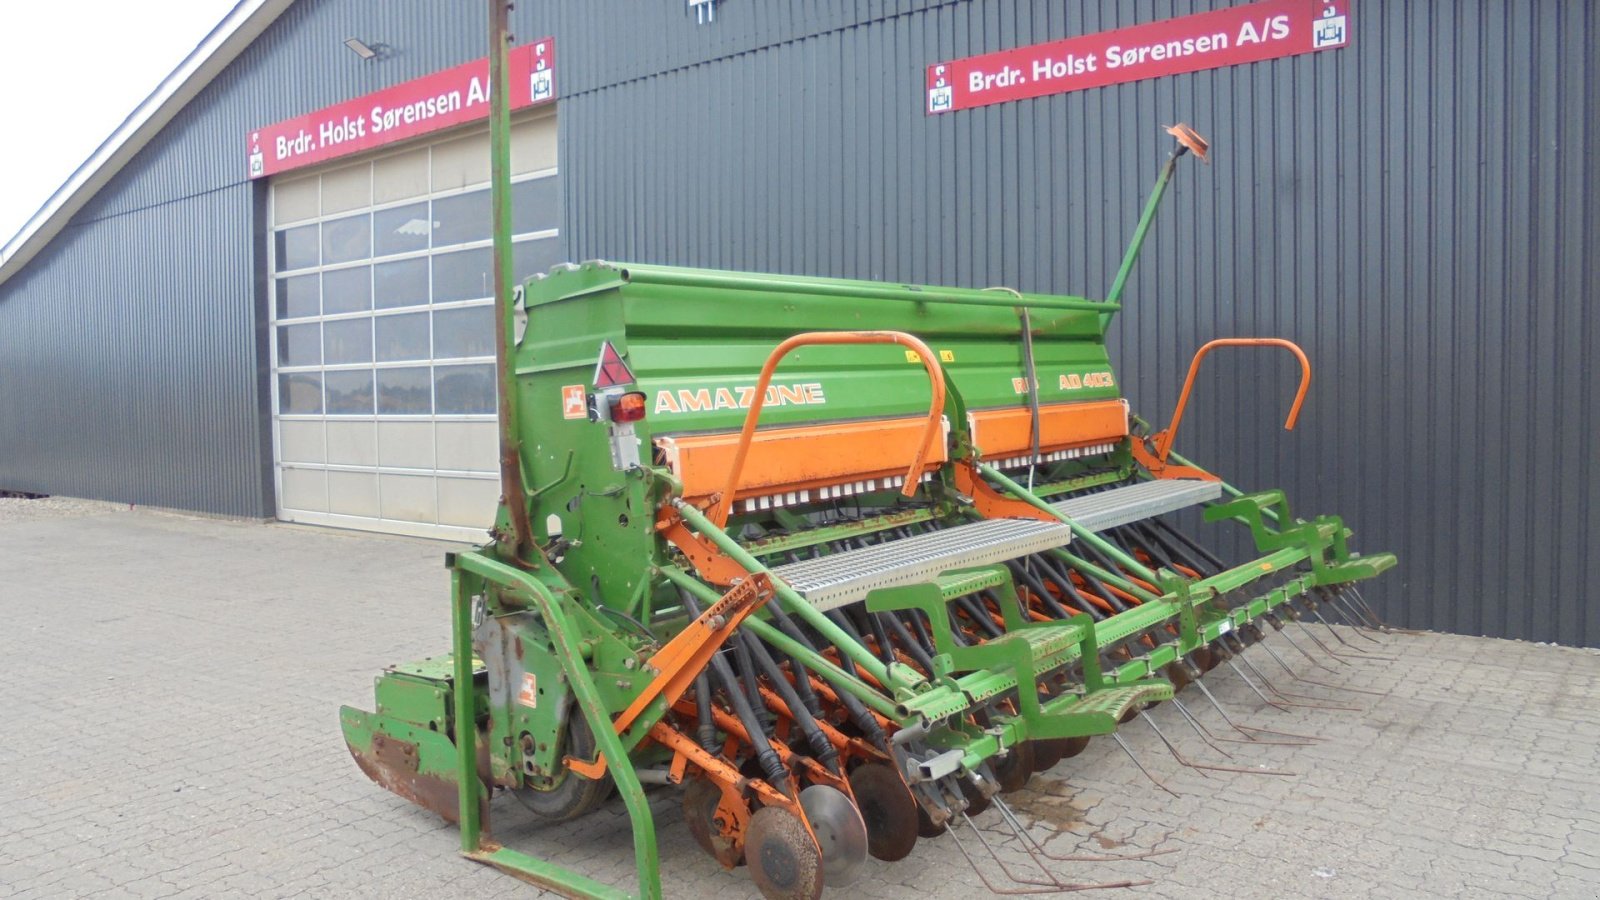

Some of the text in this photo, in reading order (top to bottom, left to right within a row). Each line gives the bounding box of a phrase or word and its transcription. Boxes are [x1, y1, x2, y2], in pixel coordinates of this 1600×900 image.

[969, 15, 1290, 93] Brdr. Holst Sørensen A/S
[276, 73, 490, 160] Brdr. Holst Sørensen A/
[655, 383, 826, 414] AMAZONE
[1083, 372, 1114, 388] 403
